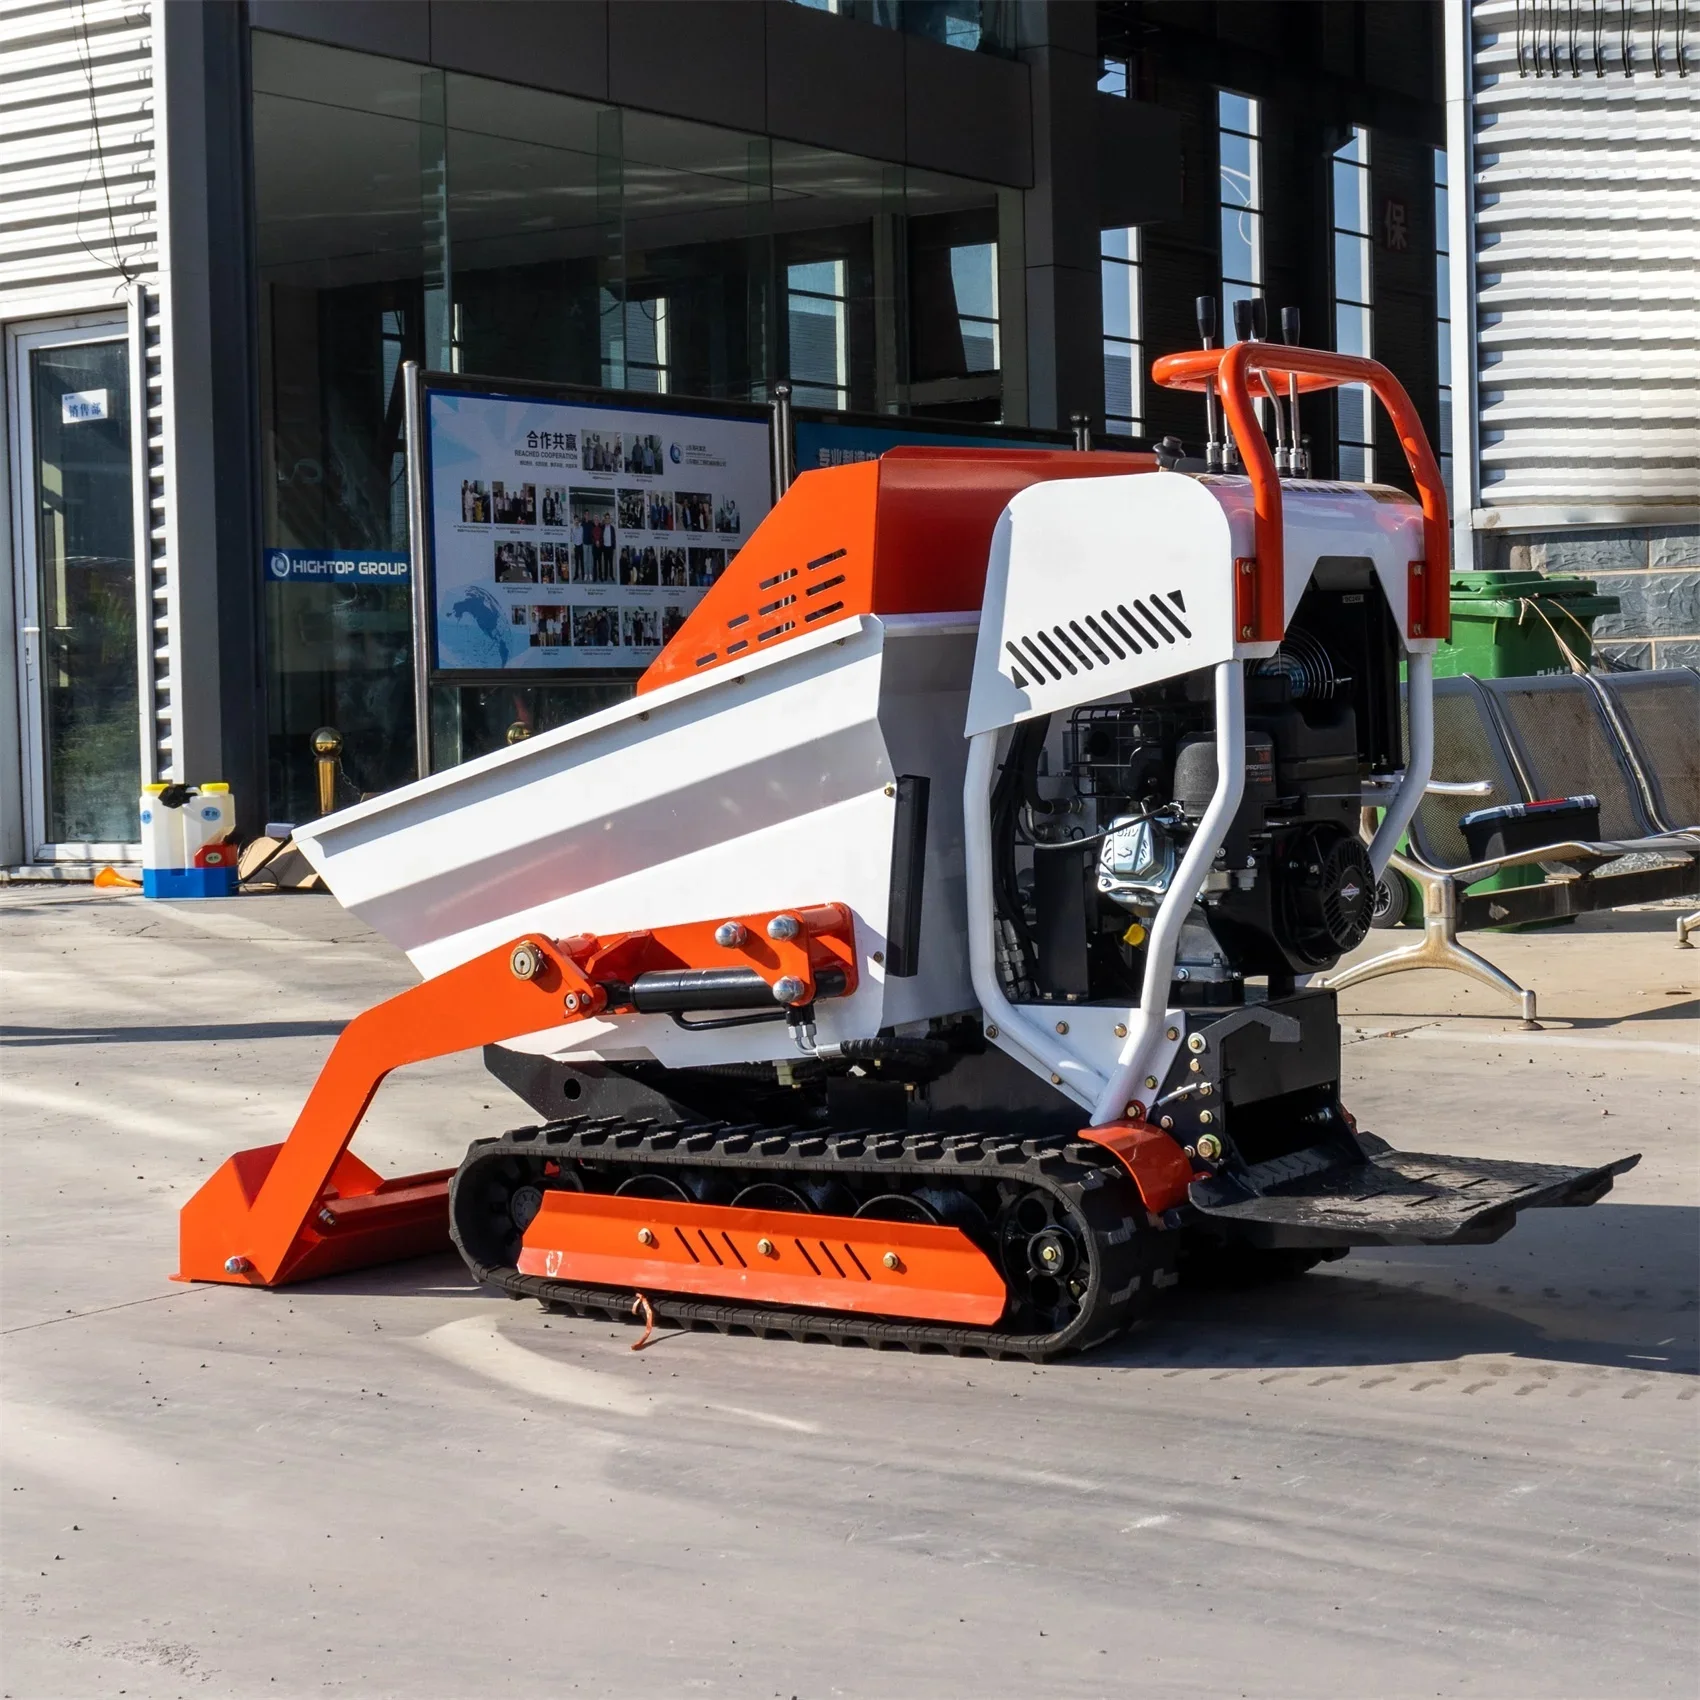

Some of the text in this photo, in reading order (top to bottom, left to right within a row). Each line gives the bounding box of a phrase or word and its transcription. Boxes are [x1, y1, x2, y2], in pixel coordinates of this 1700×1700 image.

[1384, 199, 1407, 249] 保
[69, 402, 102, 418] 销售部
[526, 430, 578, 452] 合作共赢
[514, 449, 578, 460] REACHED COOPERATION
[819, 447, 877, 467] 专业制造中
[293, 560, 407, 575] HIGHTOP GROUP
